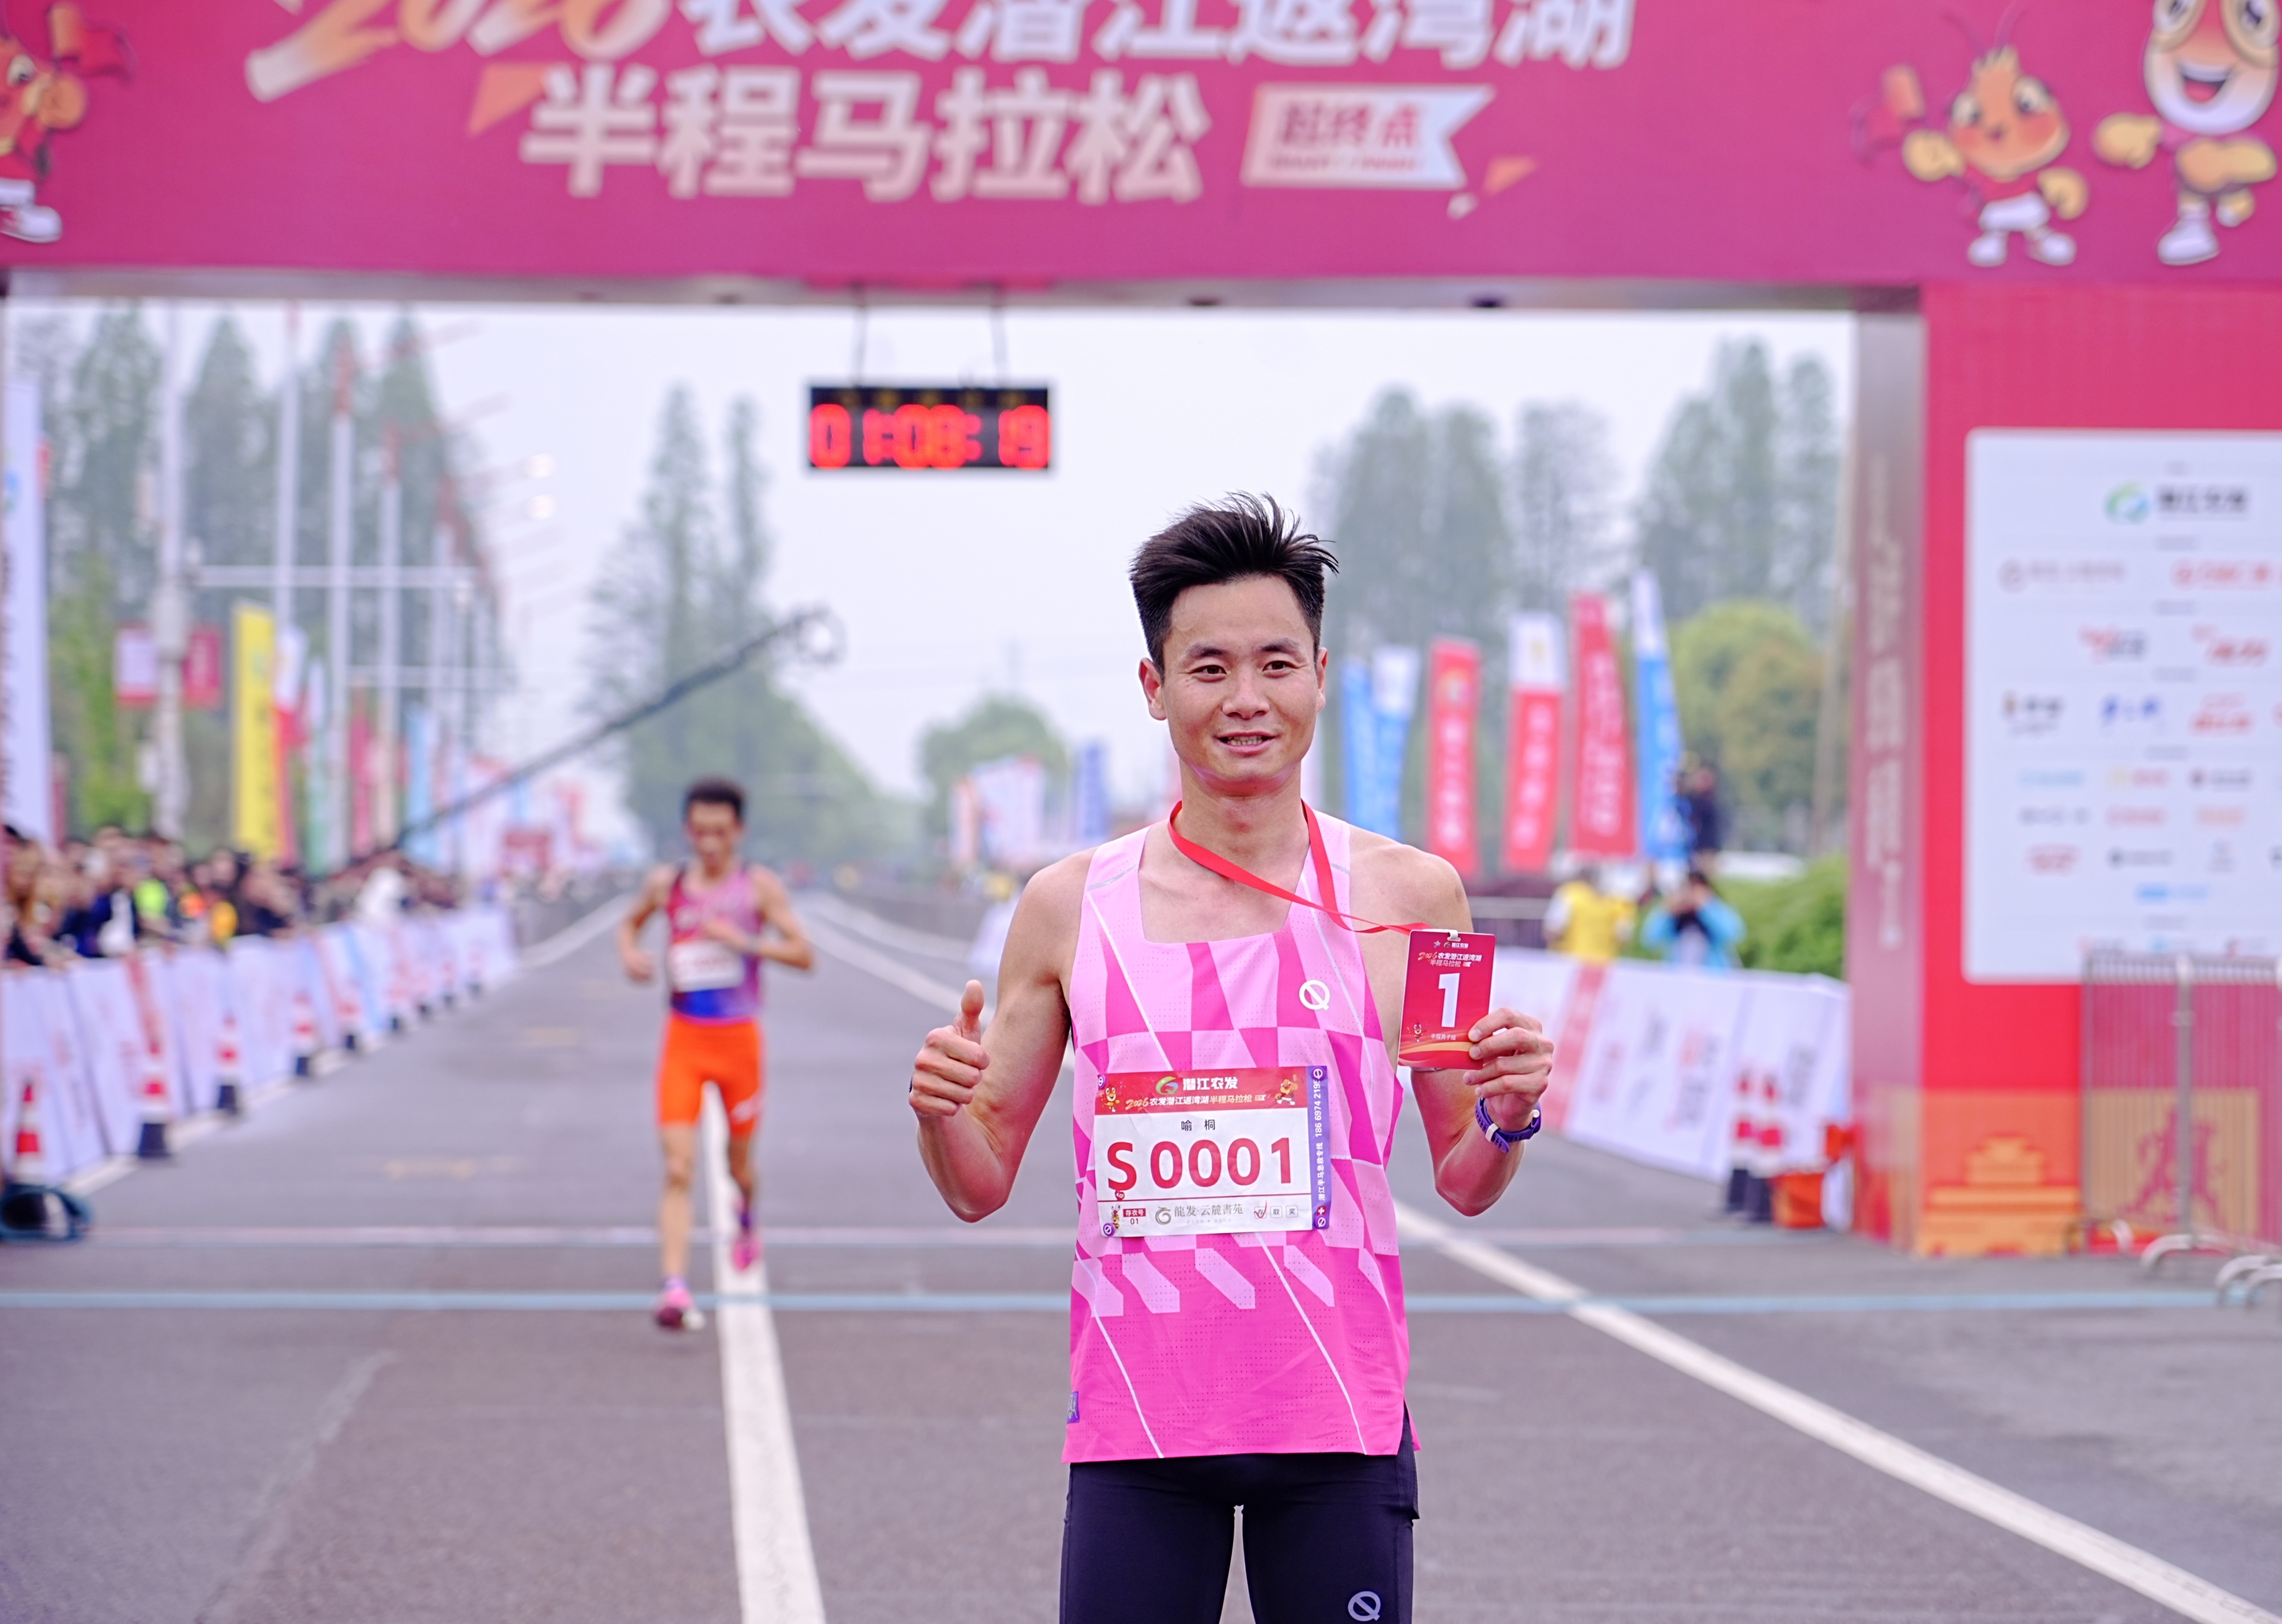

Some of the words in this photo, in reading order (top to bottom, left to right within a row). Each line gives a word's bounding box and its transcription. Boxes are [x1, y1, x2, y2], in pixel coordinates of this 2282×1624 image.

[518, 62, 1212, 204] 半程马拉松
[1439, 973, 1460, 1027] 1
[1182, 1077, 1238, 1091] 潜江农发
[1107, 1137, 1291, 1191] S0001
[1316, 1142, 1325, 1201] 潜江半马急救专线
